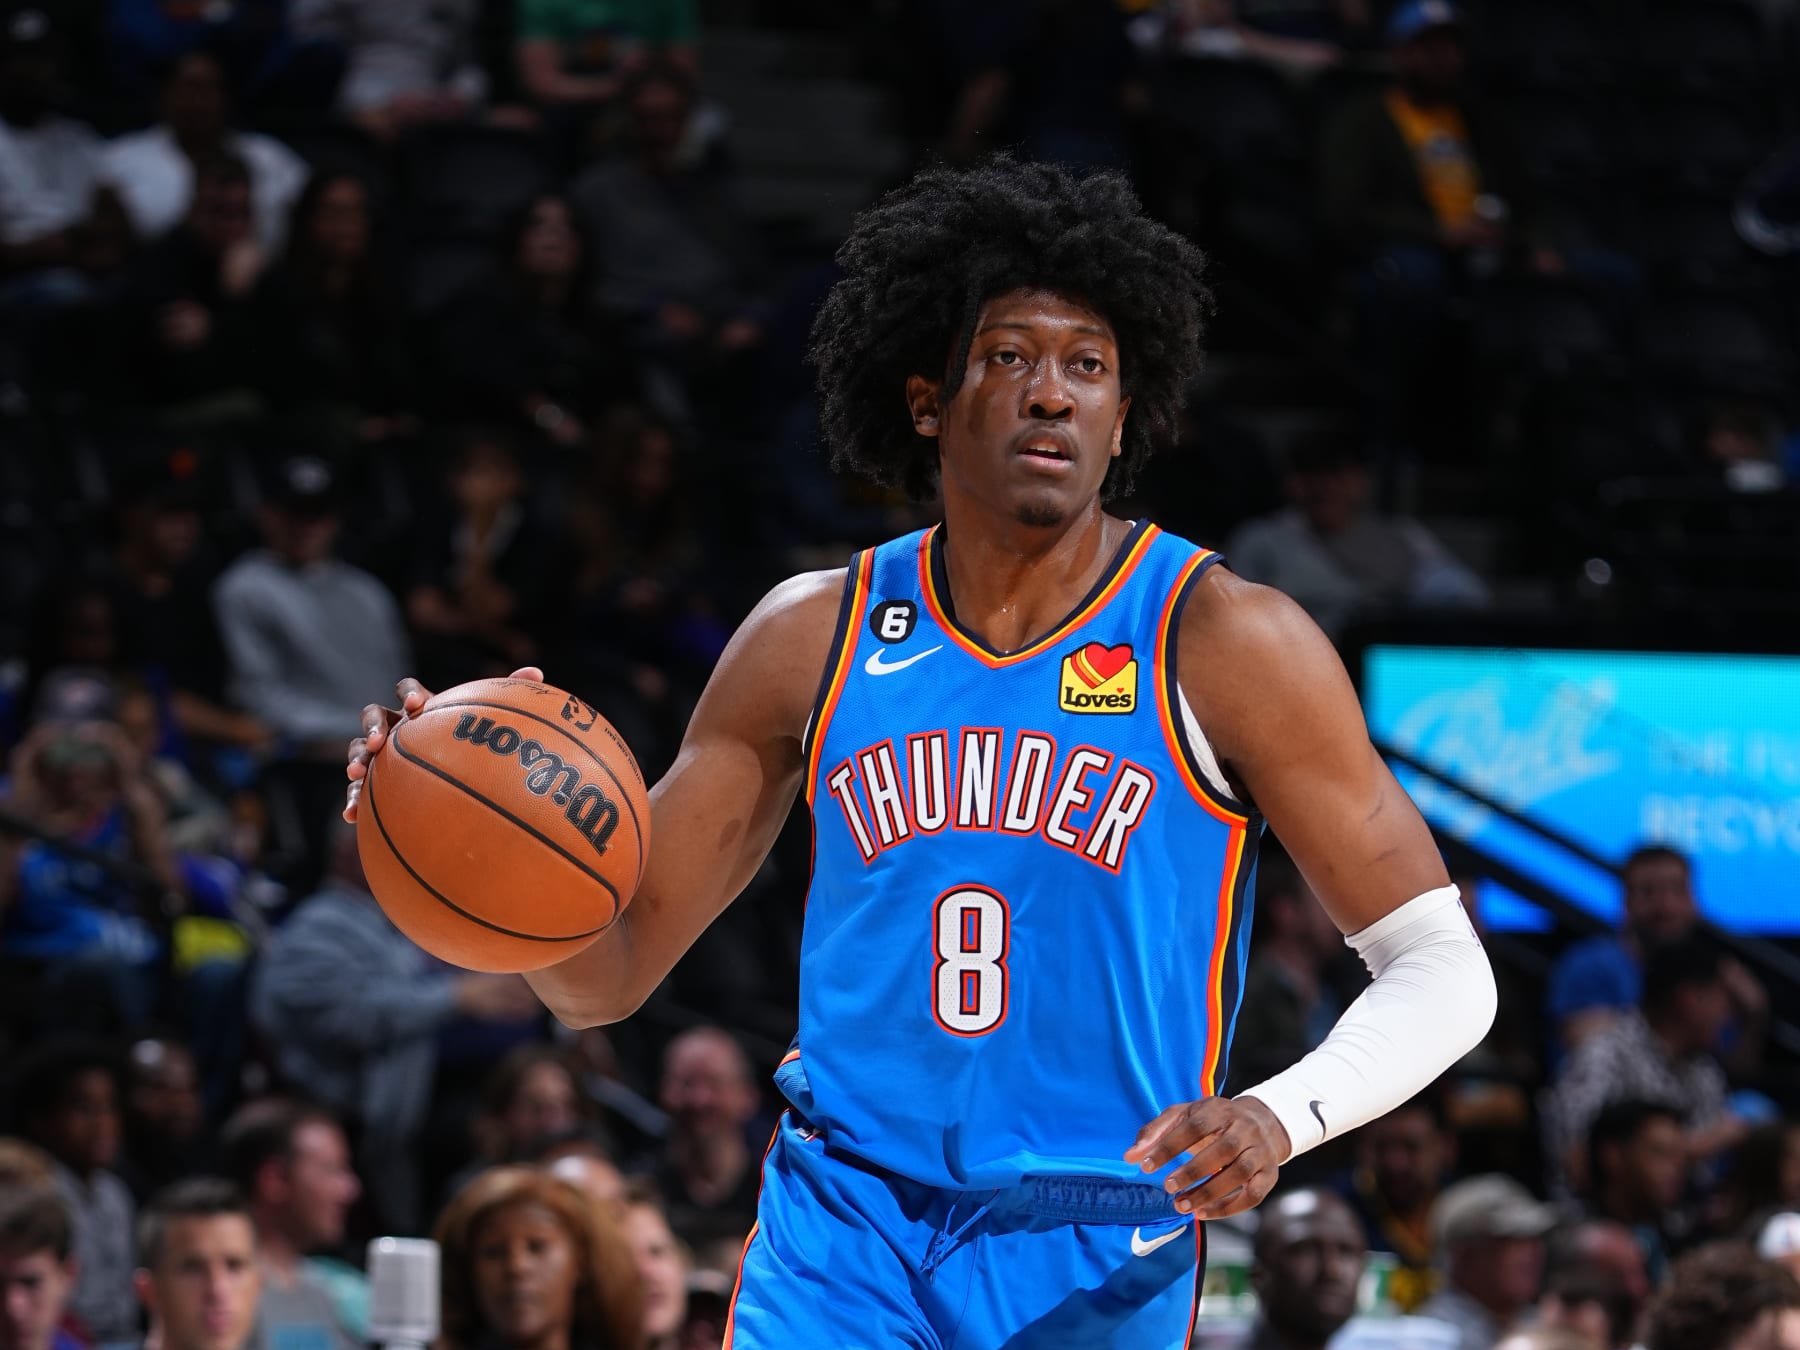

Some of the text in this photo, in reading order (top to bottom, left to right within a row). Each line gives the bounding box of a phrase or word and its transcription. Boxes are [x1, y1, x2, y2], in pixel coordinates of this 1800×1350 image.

[880, 606, 910, 639] 6
[453, 713, 620, 857] Wilson
[826, 725, 1157, 876] THUNDER
[931, 883, 1010, 1038] 8
